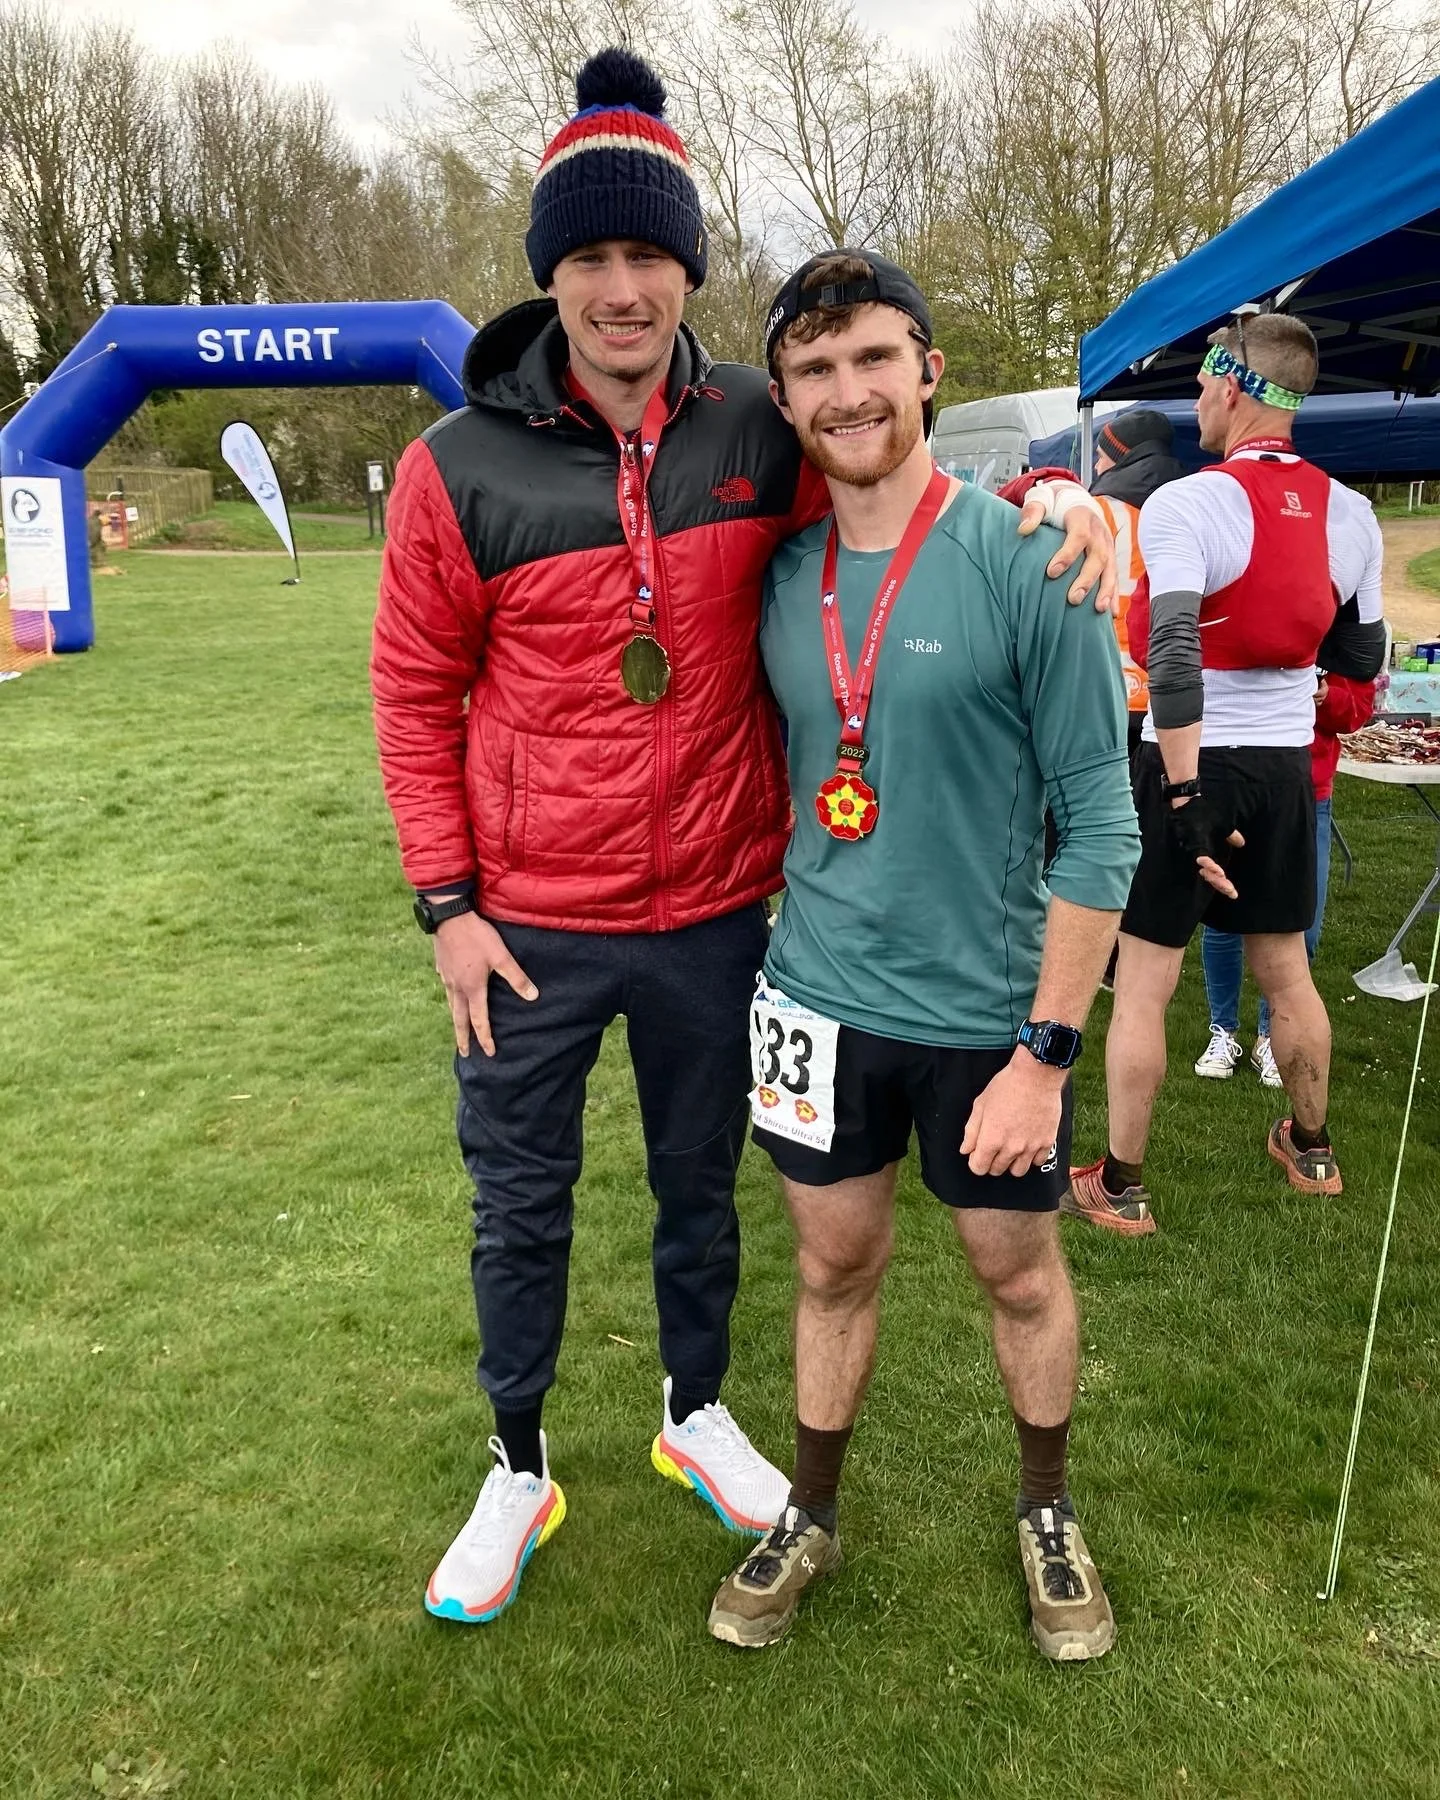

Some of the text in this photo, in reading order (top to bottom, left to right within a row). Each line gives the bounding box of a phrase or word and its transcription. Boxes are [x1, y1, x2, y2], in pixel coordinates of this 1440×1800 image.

[197, 327, 340, 363] START
[623, 478, 632, 498] The
[711, 486, 740, 497] NORTH
[723, 478, 739, 487] THE
[625, 498, 635, 511] Of
[720, 494, 741, 504] FACE
[630, 511, 638, 536] Rose
[863, 578, 897, 667] Rose Of The Shires
[914, 638, 943, 654] Rab
[833, 652, 850, 708] Rose Of The
[840, 745, 866, 759] 2022
[778, 999, 804, 1010] BE
[754, 1010, 814, 1096] 33
[763, 1115, 789, 1132] Shires
[791, 1128, 813, 1142] Ultra
[815, 1136, 827, 1147] 54
